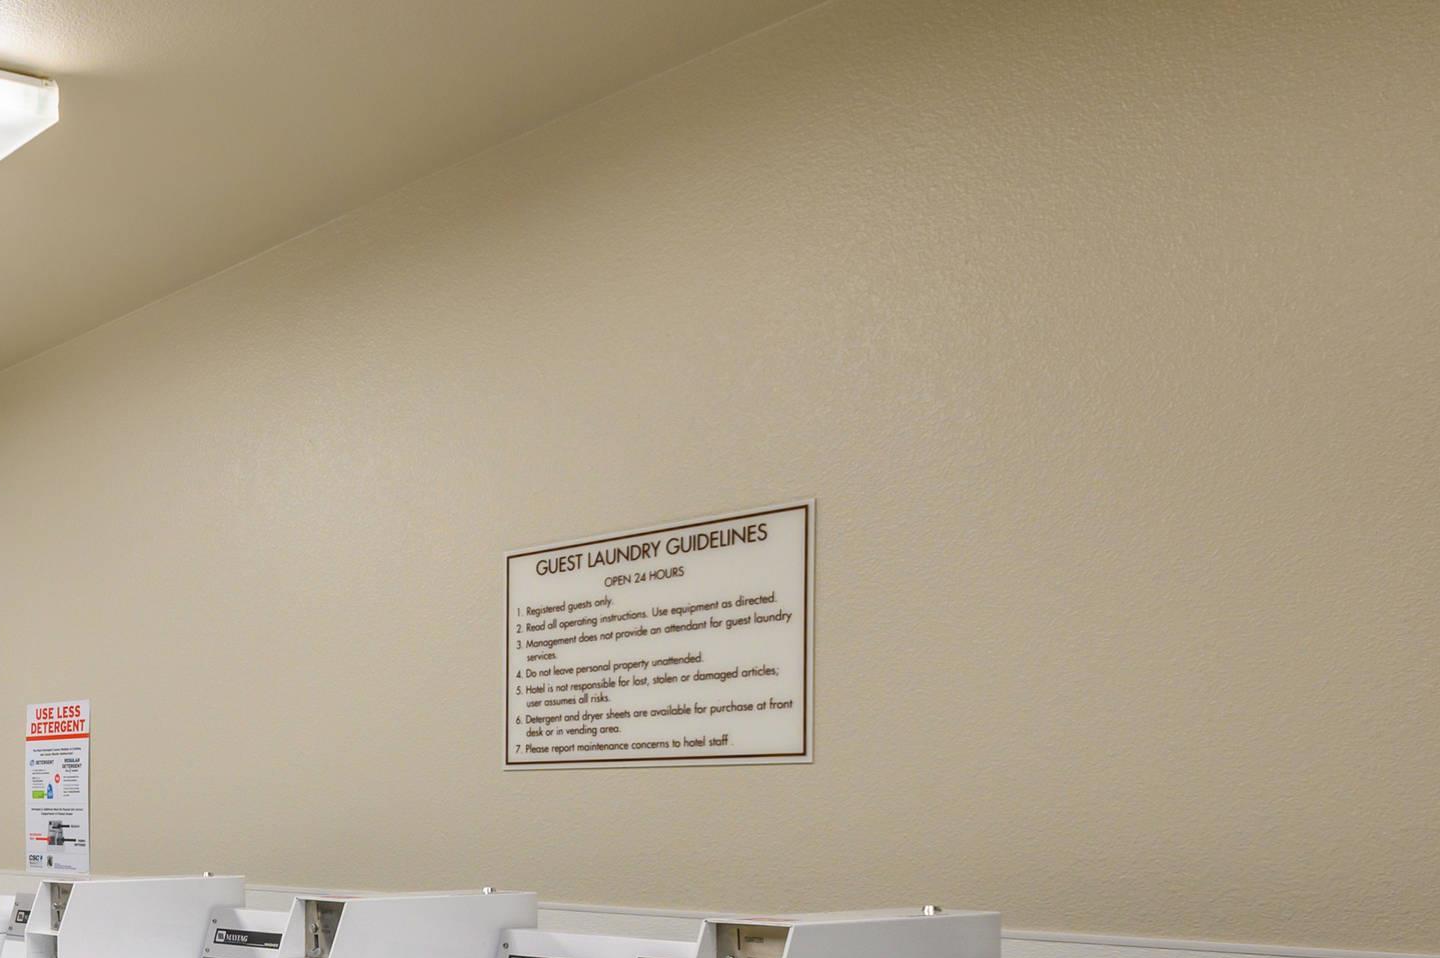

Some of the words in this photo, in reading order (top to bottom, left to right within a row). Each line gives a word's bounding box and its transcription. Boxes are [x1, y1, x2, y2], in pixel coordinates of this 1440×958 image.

[536, 554, 583, 576] GUEST
[588, 540, 661, 568] LAUNDRY
[666, 523, 768, 555] GUIDELINES
[604, 575, 631, 587] OPEN
[634, 573, 646, 584] 24
[649, 566, 685, 580] HOURS
[526, 601, 565, 617] Registered
[568, 600, 592, 613] guests
[526, 620, 546, 632] Read
[548, 618, 557, 629] all
[559, 616, 598, 630] operating
[600, 610, 648, 623] instructions.
[652, 607, 668, 617] Use
[671, 601, 719, 616] equipment
[721, 601, 733, 609] as
[735, 590, 777, 607] directed.
[526, 635, 577, 649] Management
[578, 632, 598, 643] does
[600, 632, 613, 640] not
[615, 625, 648, 641] provide
[650, 627, 661, 635] an
[664, 618, 706, 633] attendant
[710, 616, 722, 628] for
[726, 615, 751, 629] guest
[754, 608, 792, 623] laundry
[526, 669, 537, 678] Do
[539, 667, 551, 677] not
[553, 662, 574, 675] leave
[576, 660, 611, 676] personal
[613, 659, 649, 672] property
[652, 651, 704, 667] unattended.
[526, 683, 546, 694] Hotel
[547, 685, 554, 693] is
[556, 683, 568, 692] not
[570, 678, 616, 692] responsible
[618, 676, 629, 687] for
[632, 675, 649, 687] lost,
[652, 673, 678, 685] stolen
[680, 674, 691, 682] or
[693, 666, 738, 682] damaged
[741, 664, 779, 677] articles;
[526, 700, 542, 708] user
[544, 697, 576, 707] assumes
[578, 693, 589, 704] all
[590, 692, 610, 703] risks.
[35, 708, 54, 720] USE
[57, 705, 81, 719] LESS
[526, 714, 562, 725] Detergent
[564, 711, 580, 722] and
[582, 710, 604, 722] dryer
[606, 708, 631, 719] sheets
[633, 709, 648, 717] are
[650, 704, 691, 717] available
[694, 702, 706, 714] for
[710, 700, 753, 716] purchase
[756, 701, 766, 710] at
[769, 697, 793, 709] front
[31, 719, 86, 734] DETERGENT
[526, 727, 543, 737] desk
[556, 727, 564, 735] in
[566, 723, 598, 737] vending
[600, 725, 621, 734] area.
[525, 743, 549, 753] Please
[551, 744, 575, 755] report
[577, 741, 629, 751] maintenance
[631, 739, 669, 750] concerns
[672, 739, 681, 748] to
[683, 736, 706, 747] hotel
